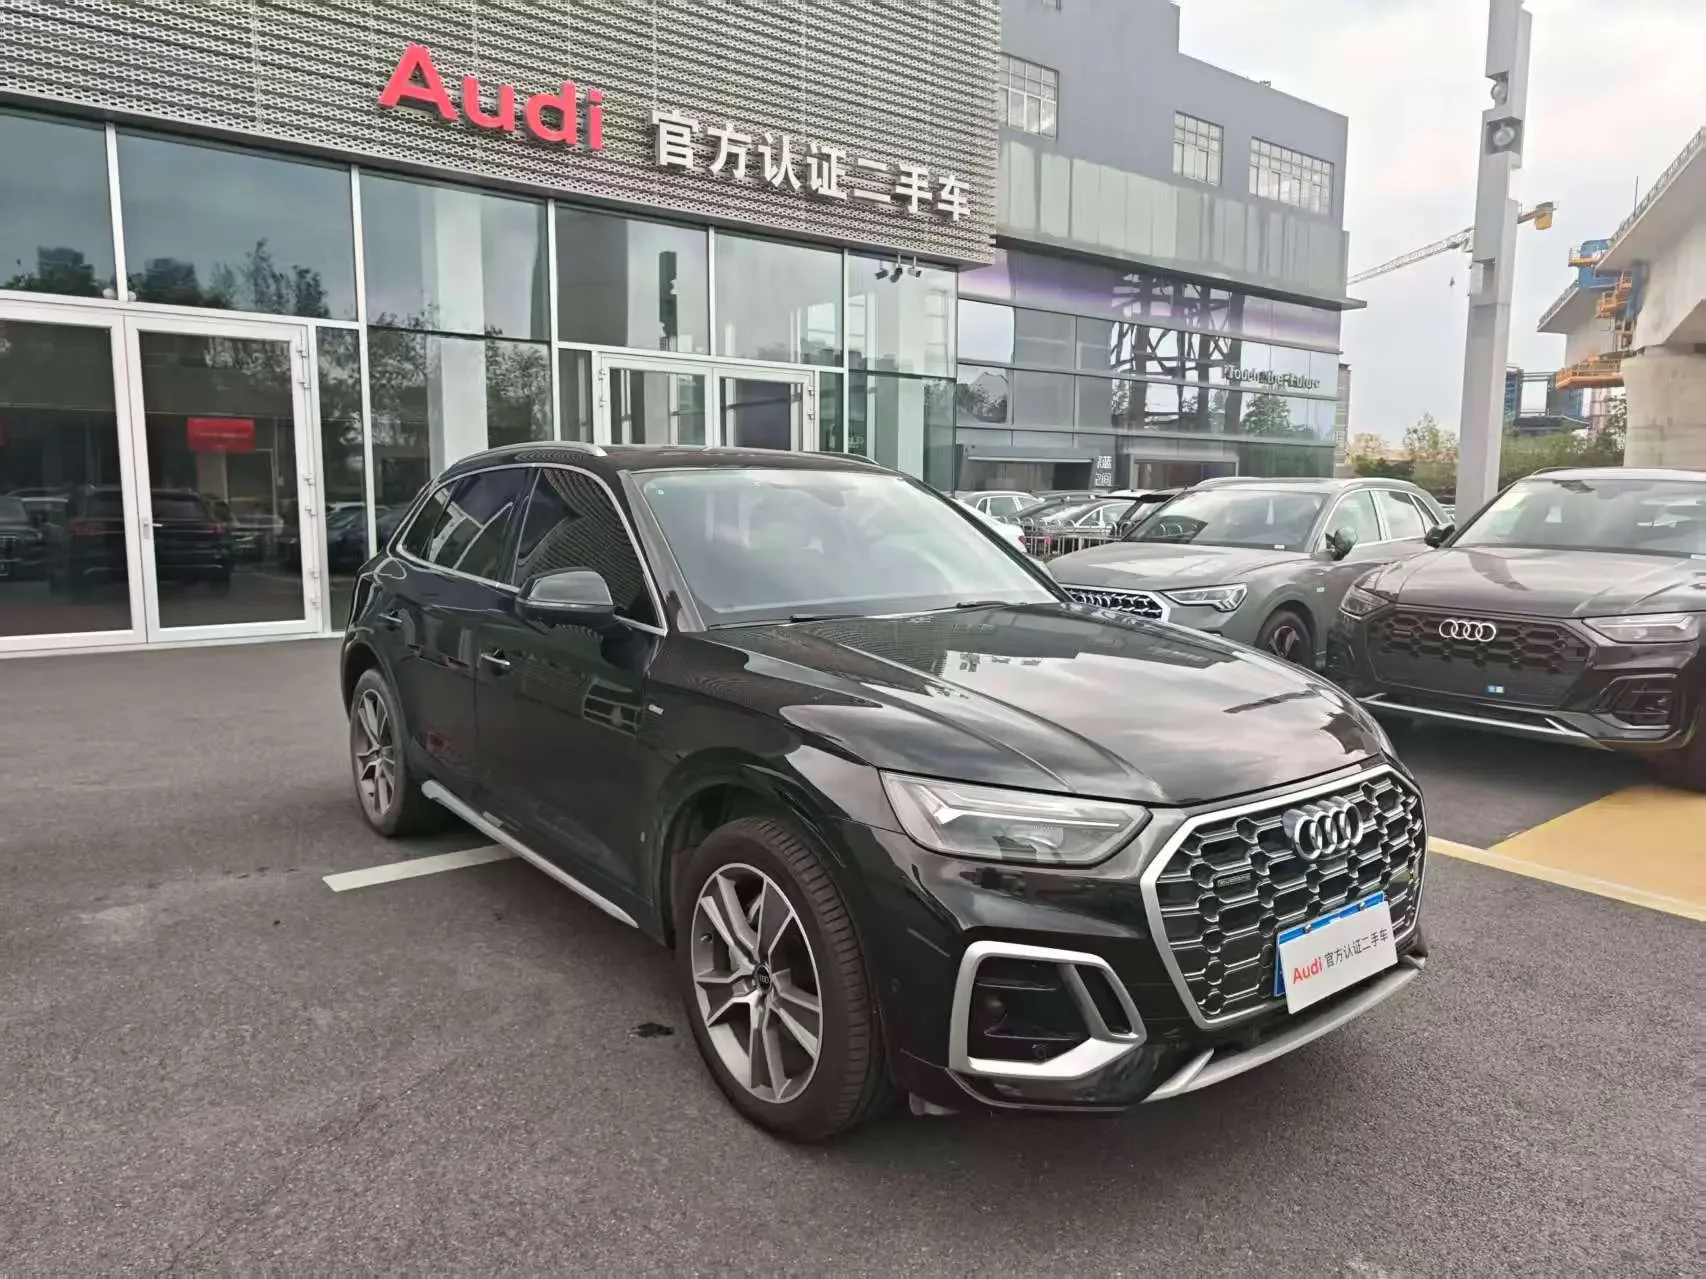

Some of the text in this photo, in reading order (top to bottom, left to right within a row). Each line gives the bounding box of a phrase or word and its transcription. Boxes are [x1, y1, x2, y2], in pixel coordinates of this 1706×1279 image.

[378, 42, 971, 221] Audi 官方认证二手车
[1292, 928, 1389, 985] Audi 官方认证二手车
